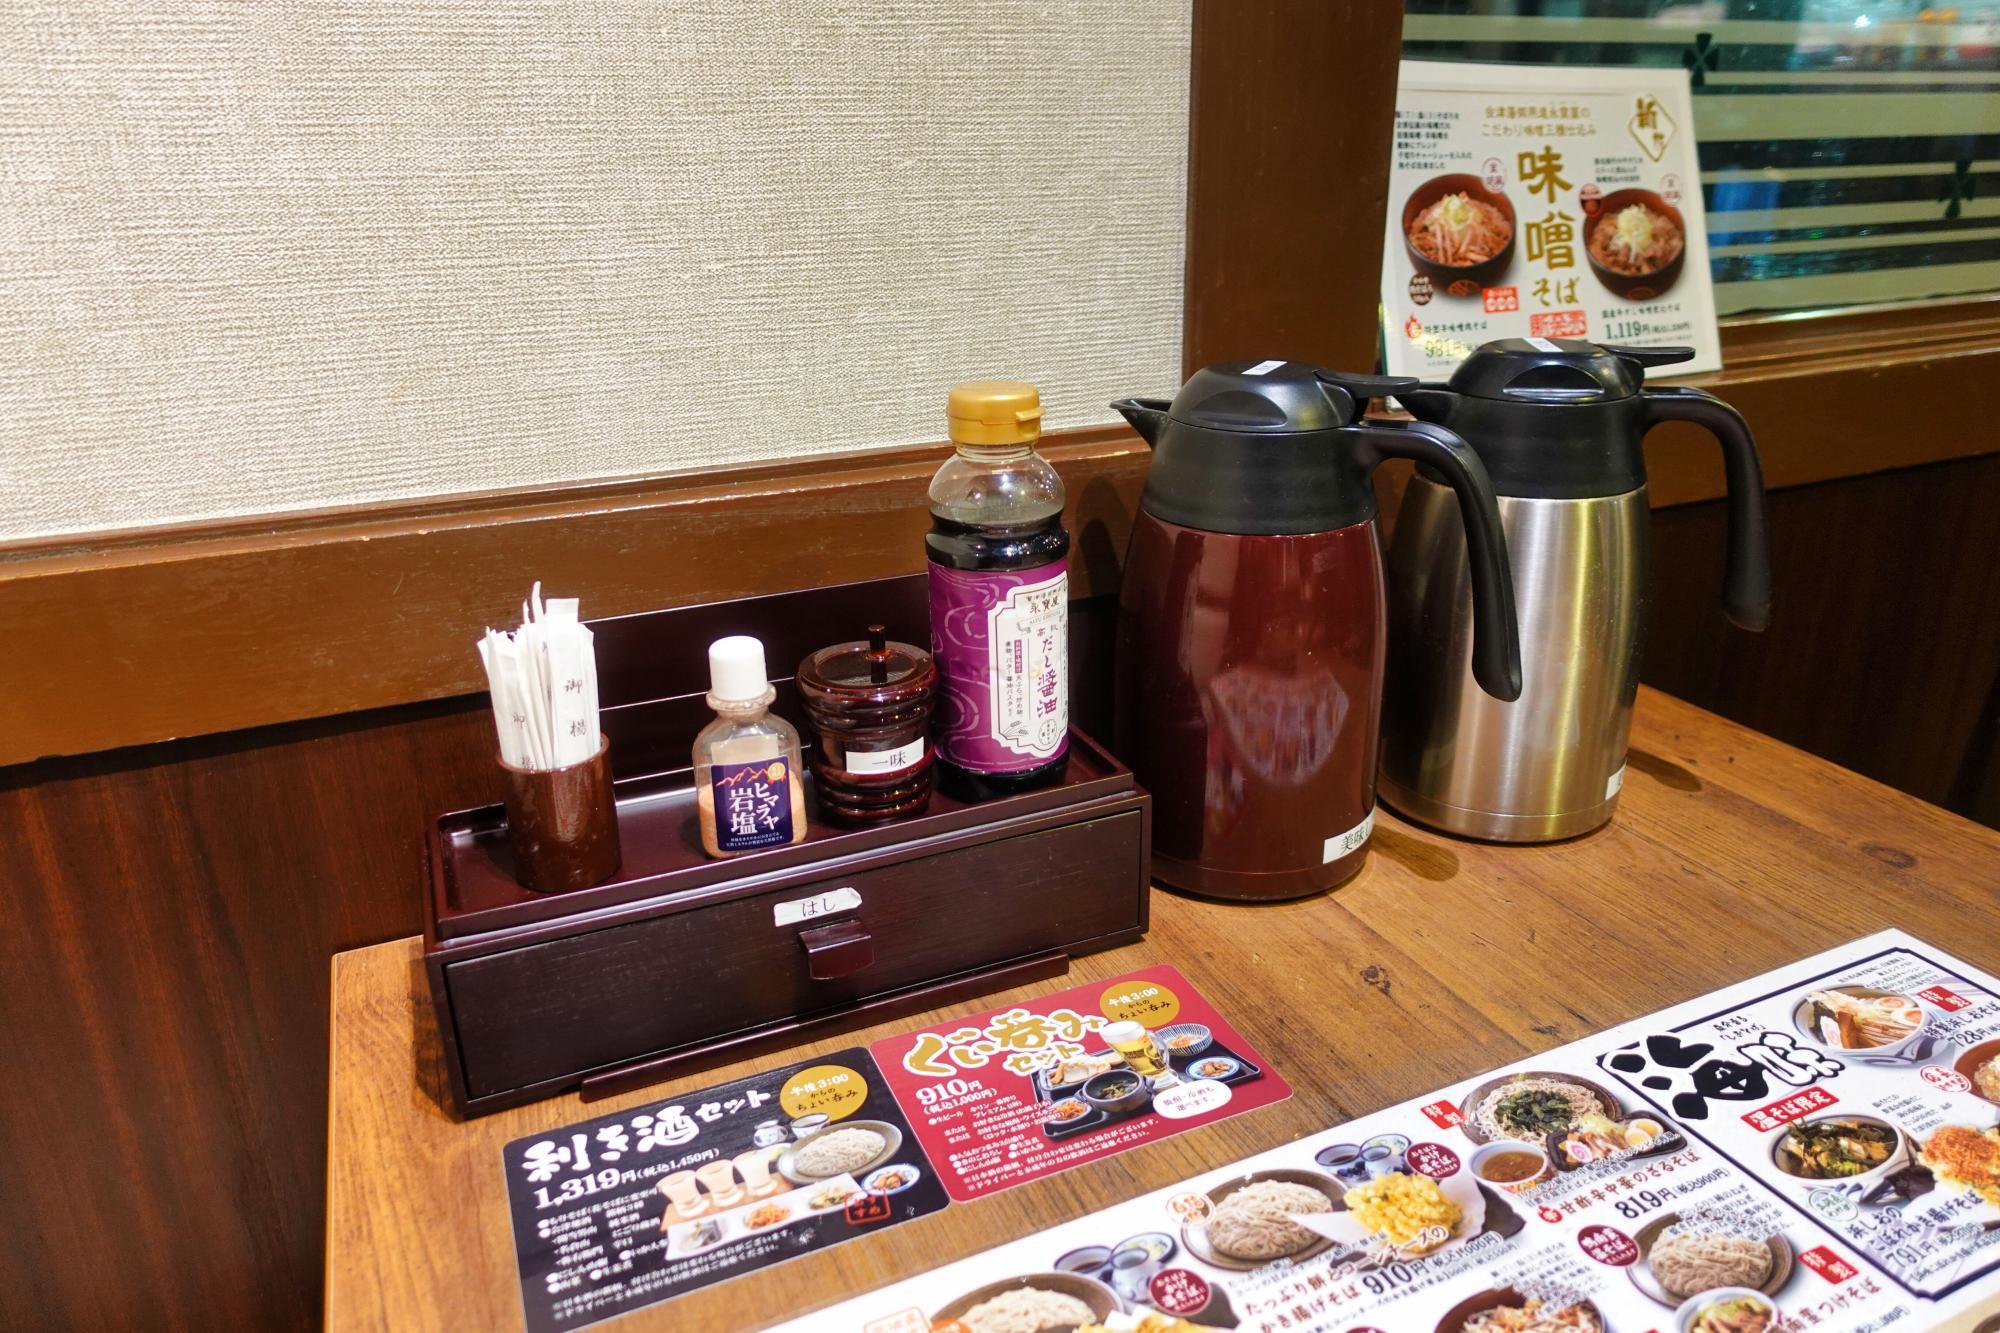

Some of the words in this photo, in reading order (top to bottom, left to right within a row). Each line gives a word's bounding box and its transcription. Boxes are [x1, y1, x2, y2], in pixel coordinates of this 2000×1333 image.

[1517, 144, 1576, 271] 味噌
[1531, 276, 1580, 307] そば
[871, 751, 907, 769] 一味
[729, 787, 758, 835] 岩塩
[754, 782, 780, 830] ヒマラヤ
[801, 896, 837, 918] はし
[904, 1008, 1108, 1077] ぐい呑み
[1003, 1042, 1086, 1076] セット
[915, 1079, 984, 1106] 910円
[1749, 1089, 1832, 1130] 温そば限定
[521, 1088, 772, 1183] 利き酒セット
